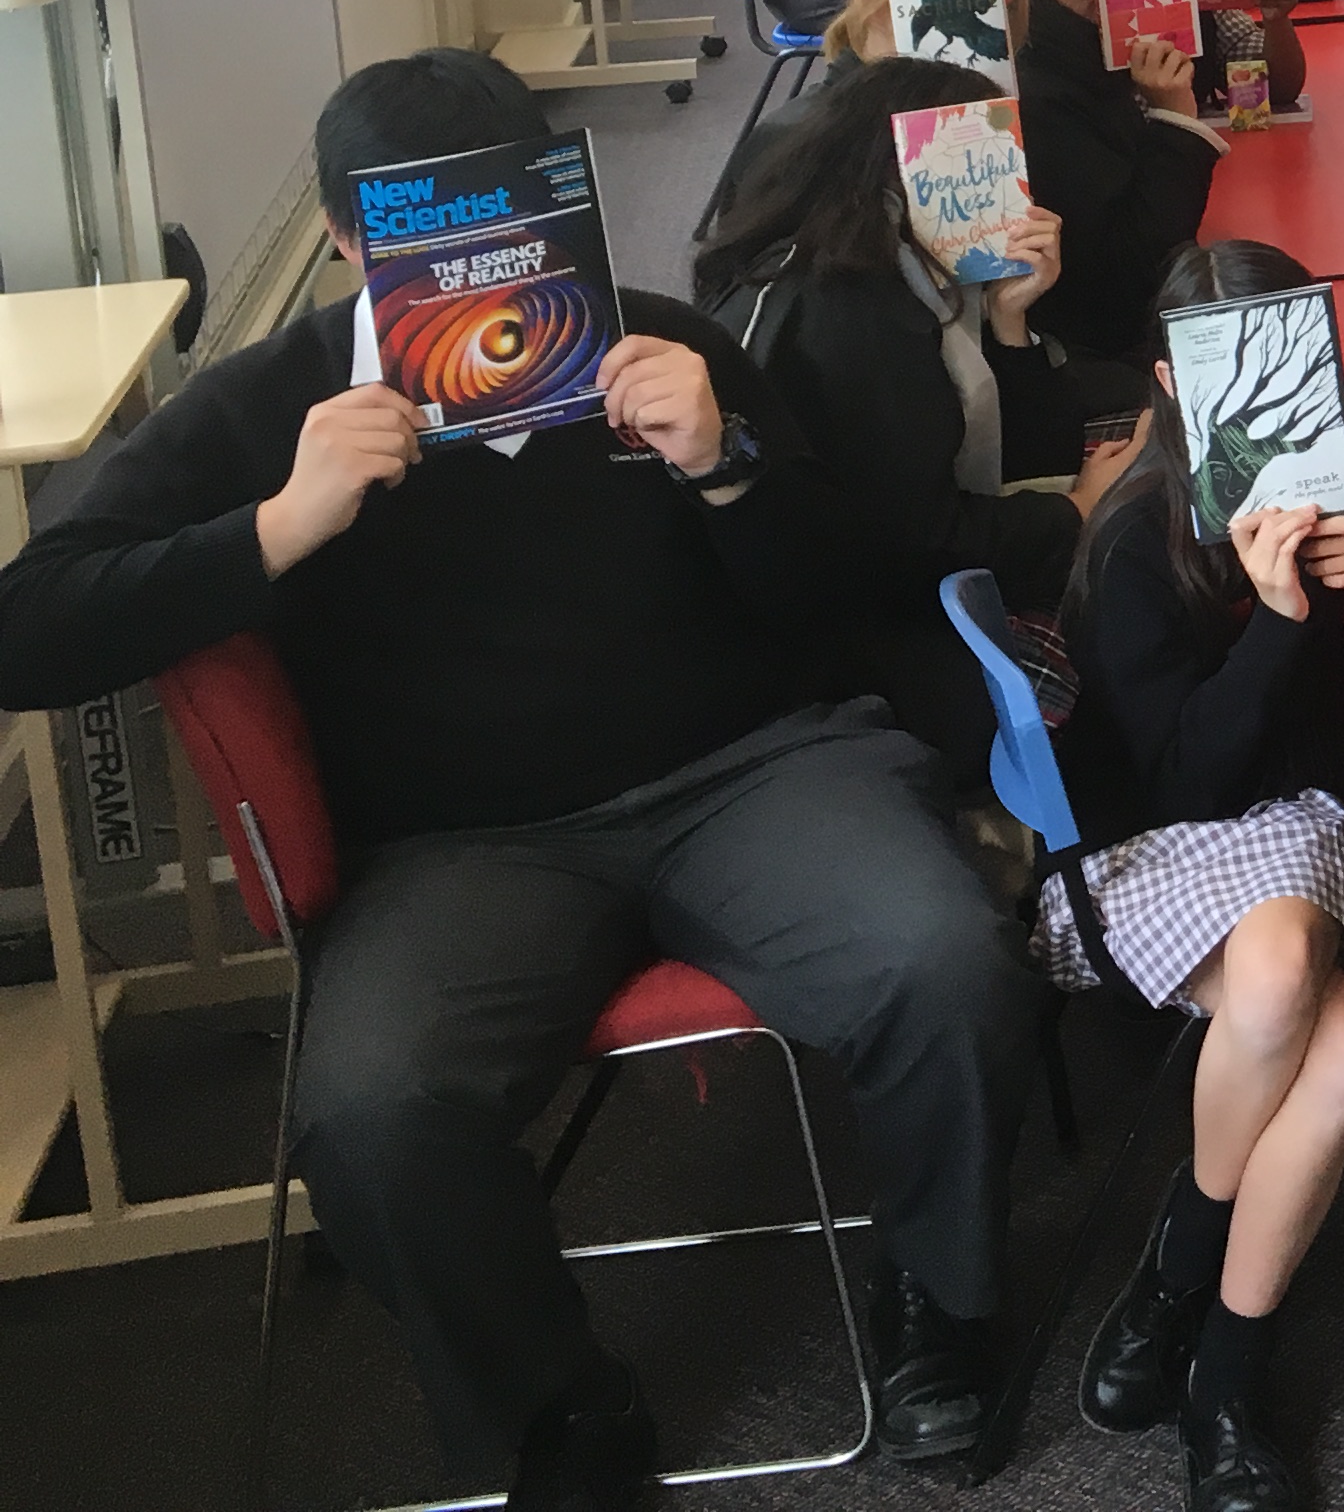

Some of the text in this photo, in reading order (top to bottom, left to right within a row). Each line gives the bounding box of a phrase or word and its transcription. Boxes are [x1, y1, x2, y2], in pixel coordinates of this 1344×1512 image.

[358, 176, 434, 211] New
[910, 147, 1019, 207] Beautiful
[364, 185, 514, 239] Scientist
[936, 190, 995, 236] Mess
[429, 240, 547, 280] THE ESSENCE
[439, 257, 544, 292] OF REALITY
[1295, 471, 1340, 489] speak
